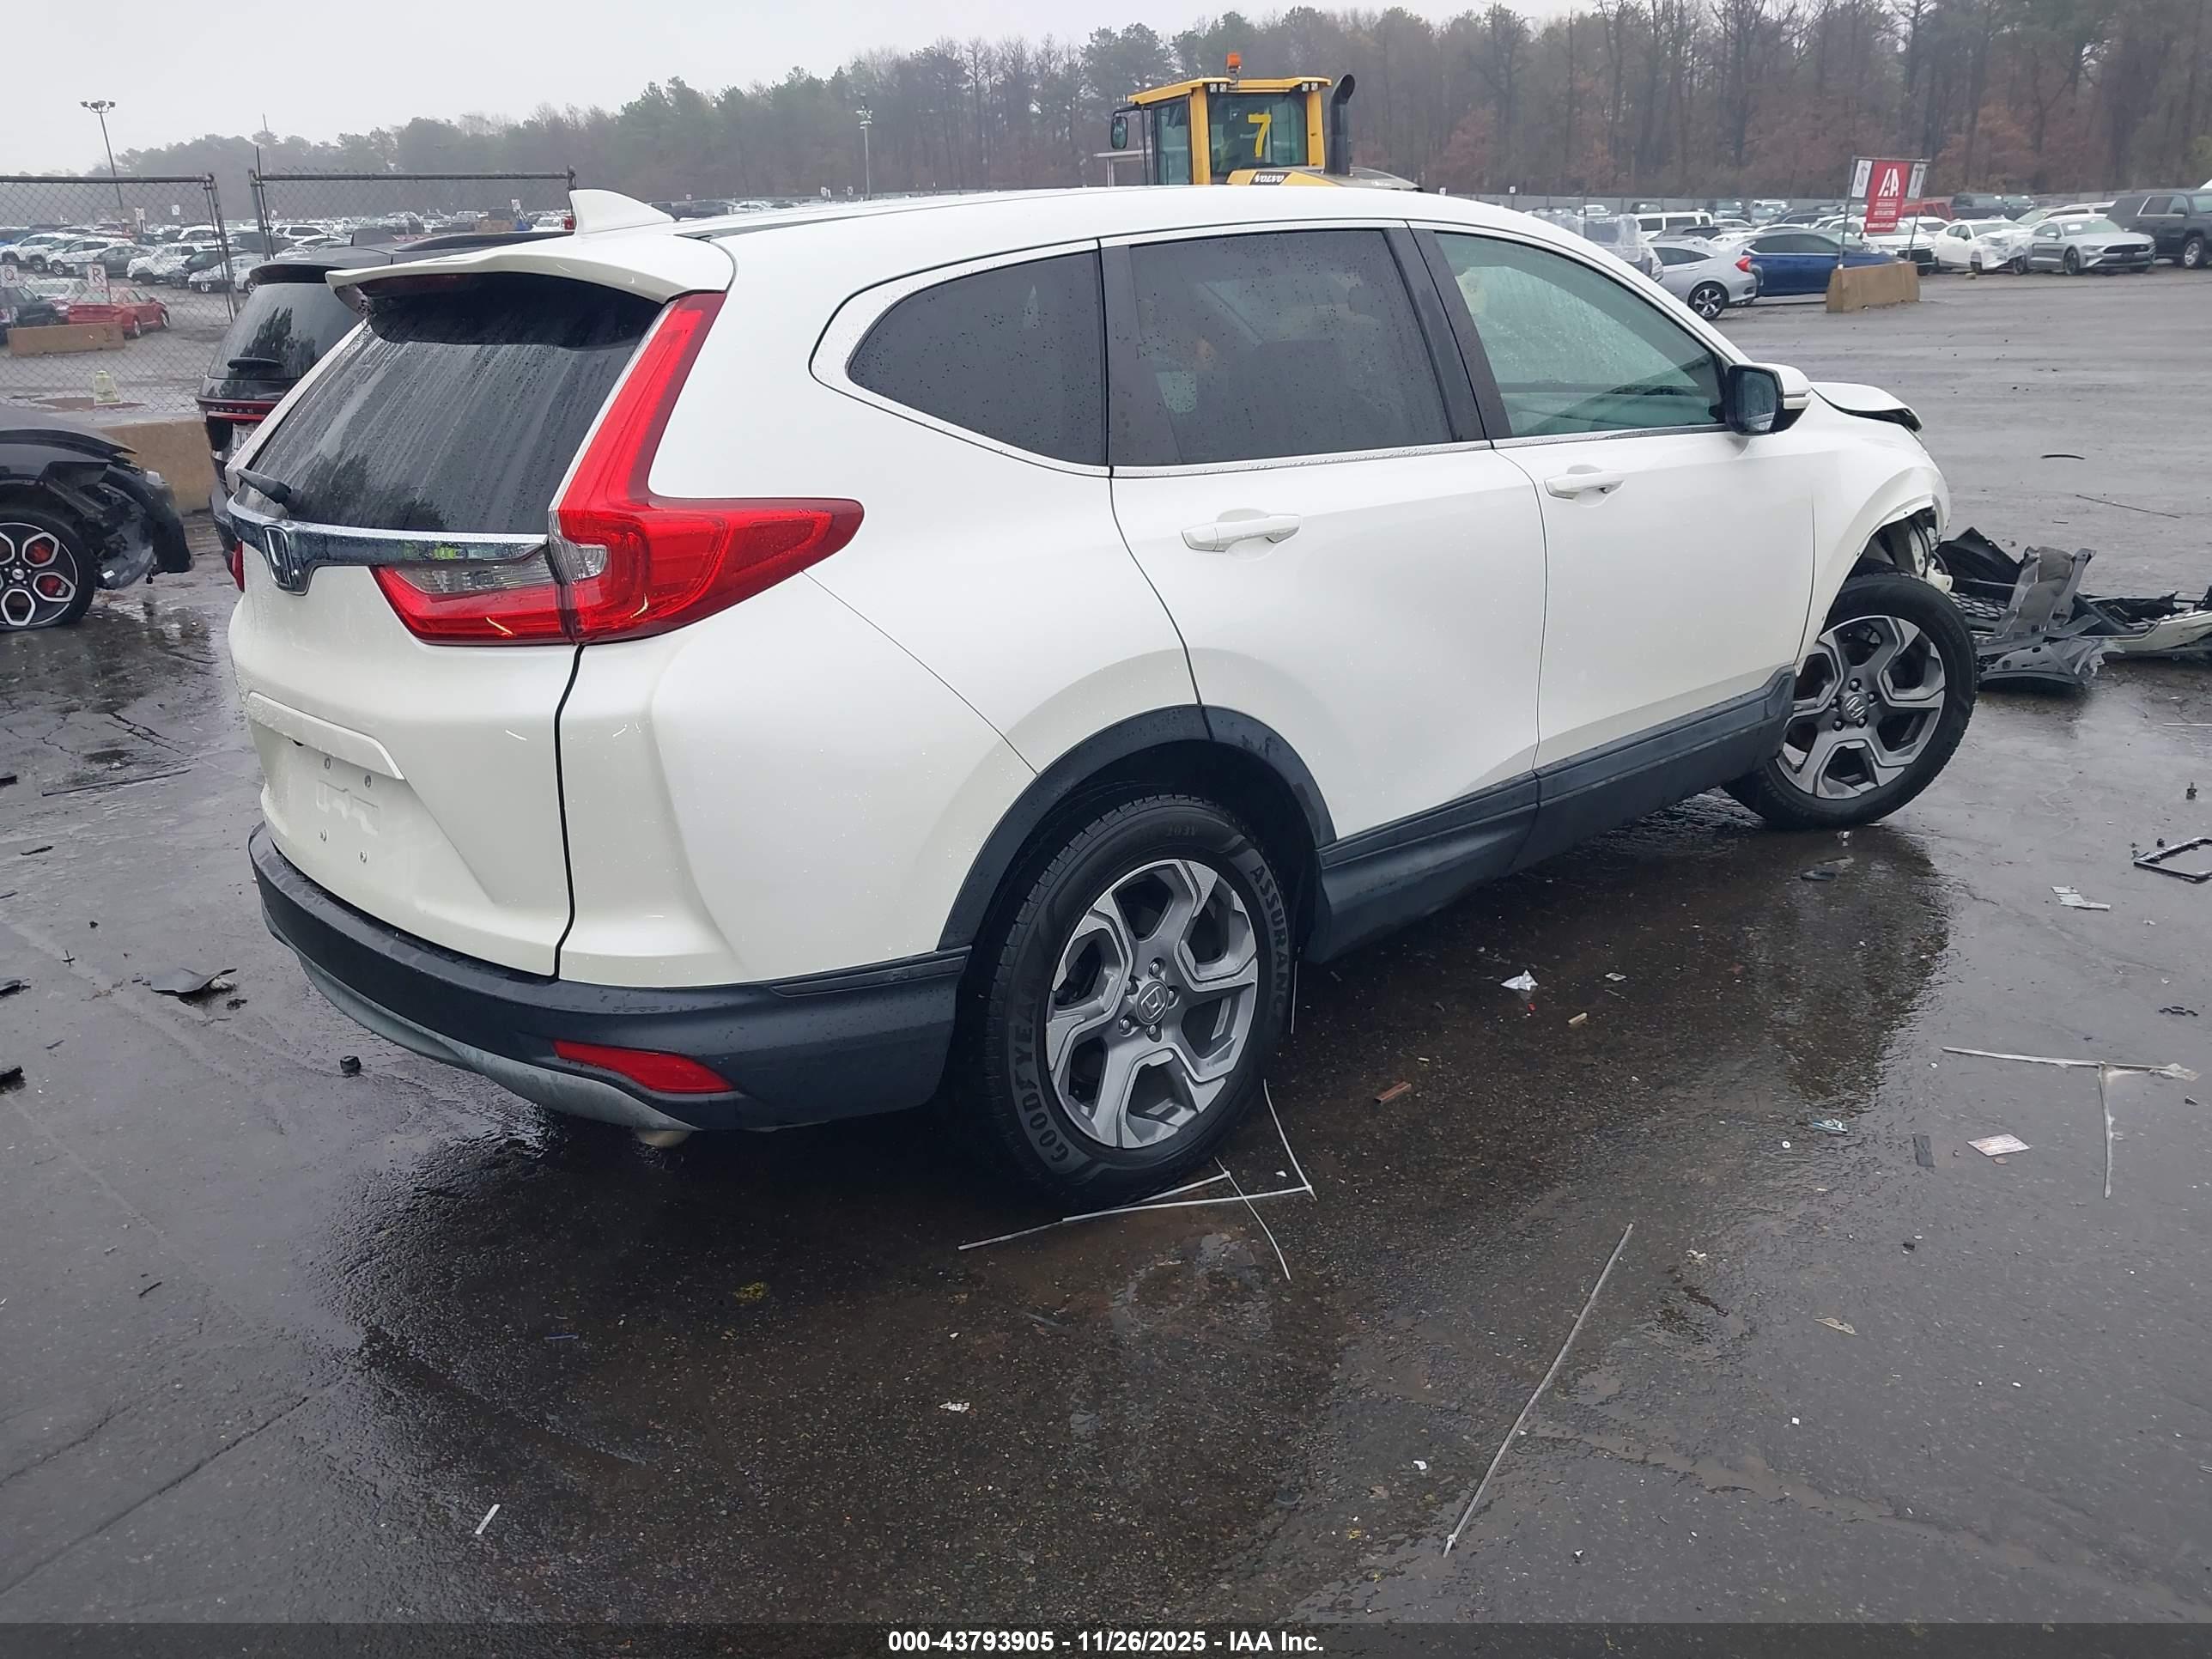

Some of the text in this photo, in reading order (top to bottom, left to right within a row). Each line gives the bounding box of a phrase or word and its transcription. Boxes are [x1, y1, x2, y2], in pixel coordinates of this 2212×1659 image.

[1248, 113, 1272, 157] 7
[1254, 173, 1285, 184] VOLVO
[1913, 167, 1924, 189] T
[91, 267, 105, 283] R
[1249, 864, 1290, 1020] ASSURANC
